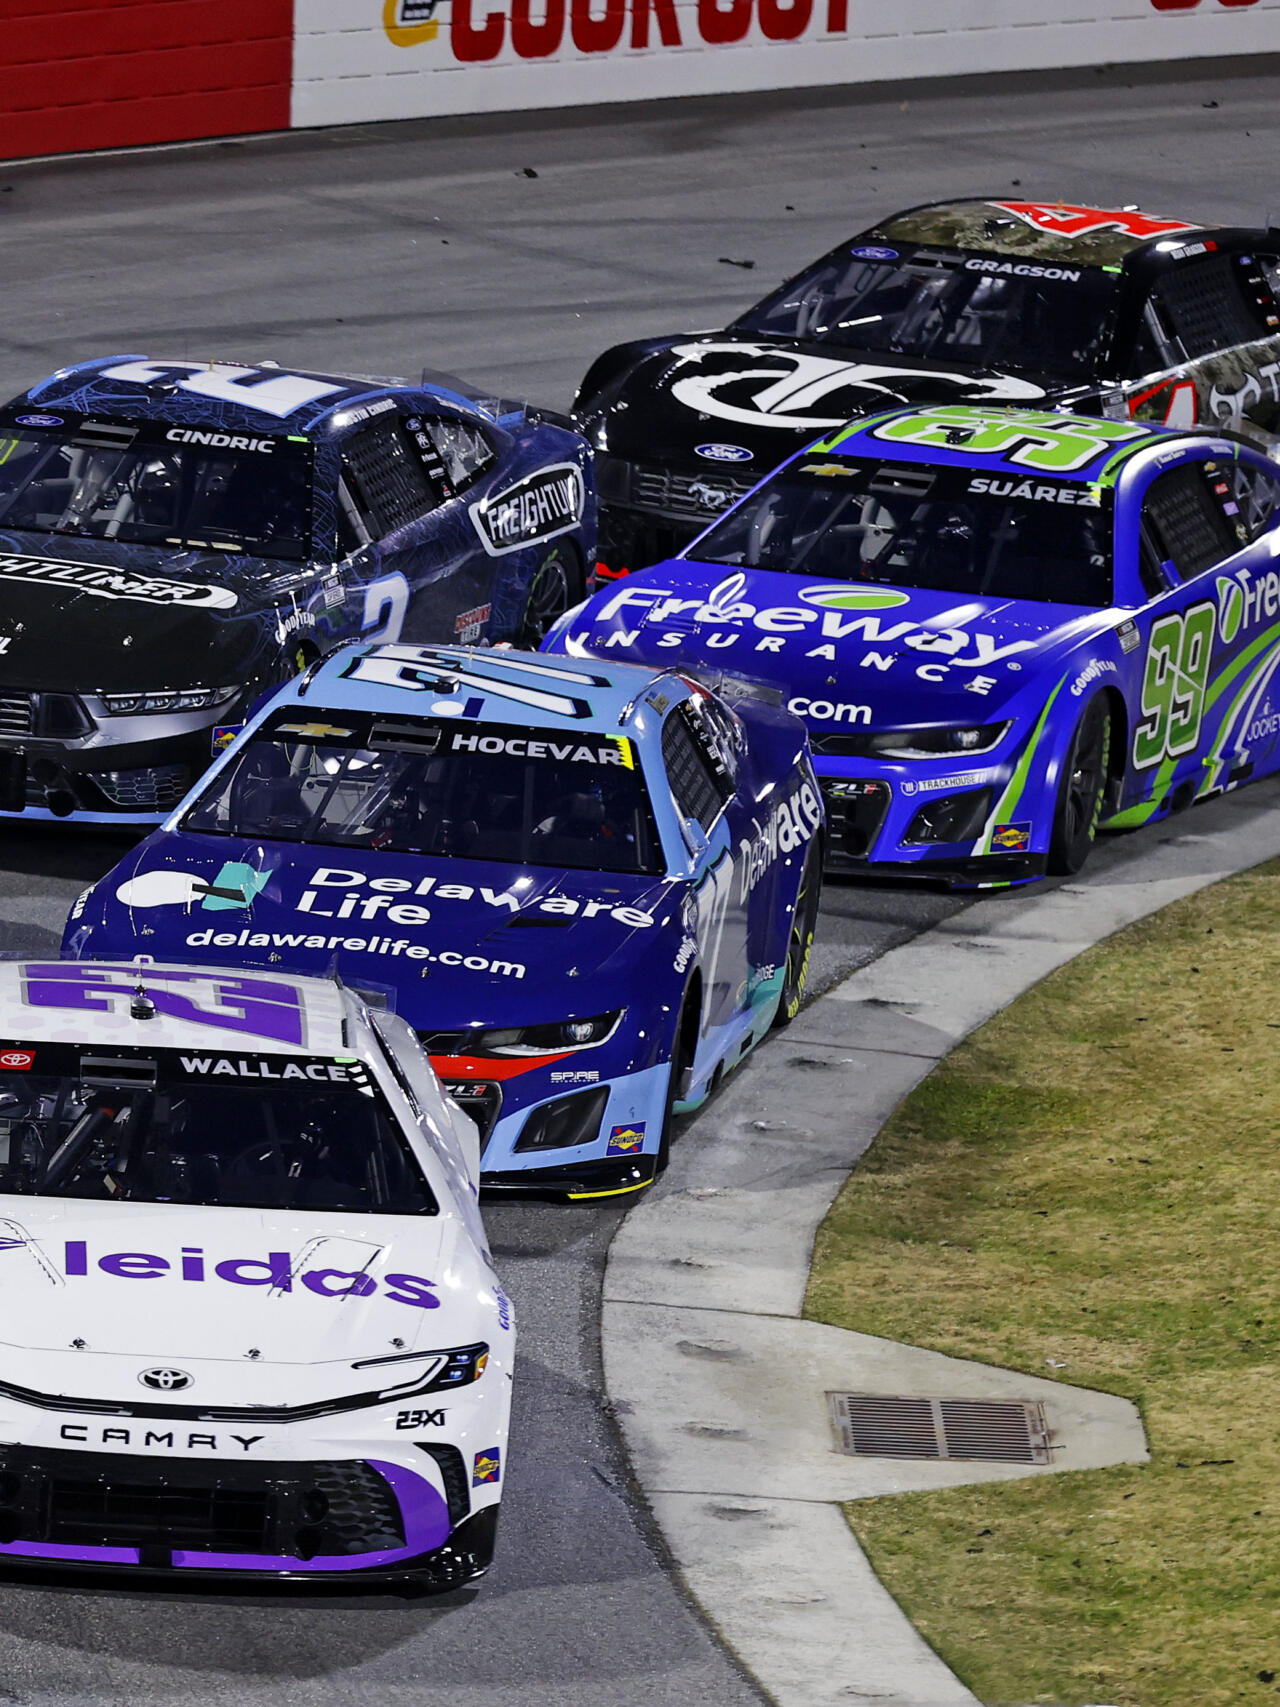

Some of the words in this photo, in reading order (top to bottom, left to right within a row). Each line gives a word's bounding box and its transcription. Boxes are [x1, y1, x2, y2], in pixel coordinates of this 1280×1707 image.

[964, 258, 1082, 282] GRAGSON
[166, 428, 276, 454] CINDRIC
[968, 479, 1102, 507] SUÁREZ
[595, 587, 1039, 668] Freeway
[574, 630, 997, 696] INSURANCE
[1070, 657, 1118, 697] GOODYEAR
[1133, 601, 1216, 770] 99
[451, 733, 624, 767] HOCEVAR
[921, 774, 978, 792] TRACKHOUSE
[295, 890, 431, 928] Life
[308, 867, 655, 928] Delaware
[185, 928, 526, 980] delawarelife.com
[179, 1056, 350, 1083] WALLACE
[550, 1070, 600, 1081] SPIRE
[609, 1133, 644, 1146] SUNOCO
[64, 1240, 442, 1311] leidos
[60, 1424, 266, 1452] CAMRY
